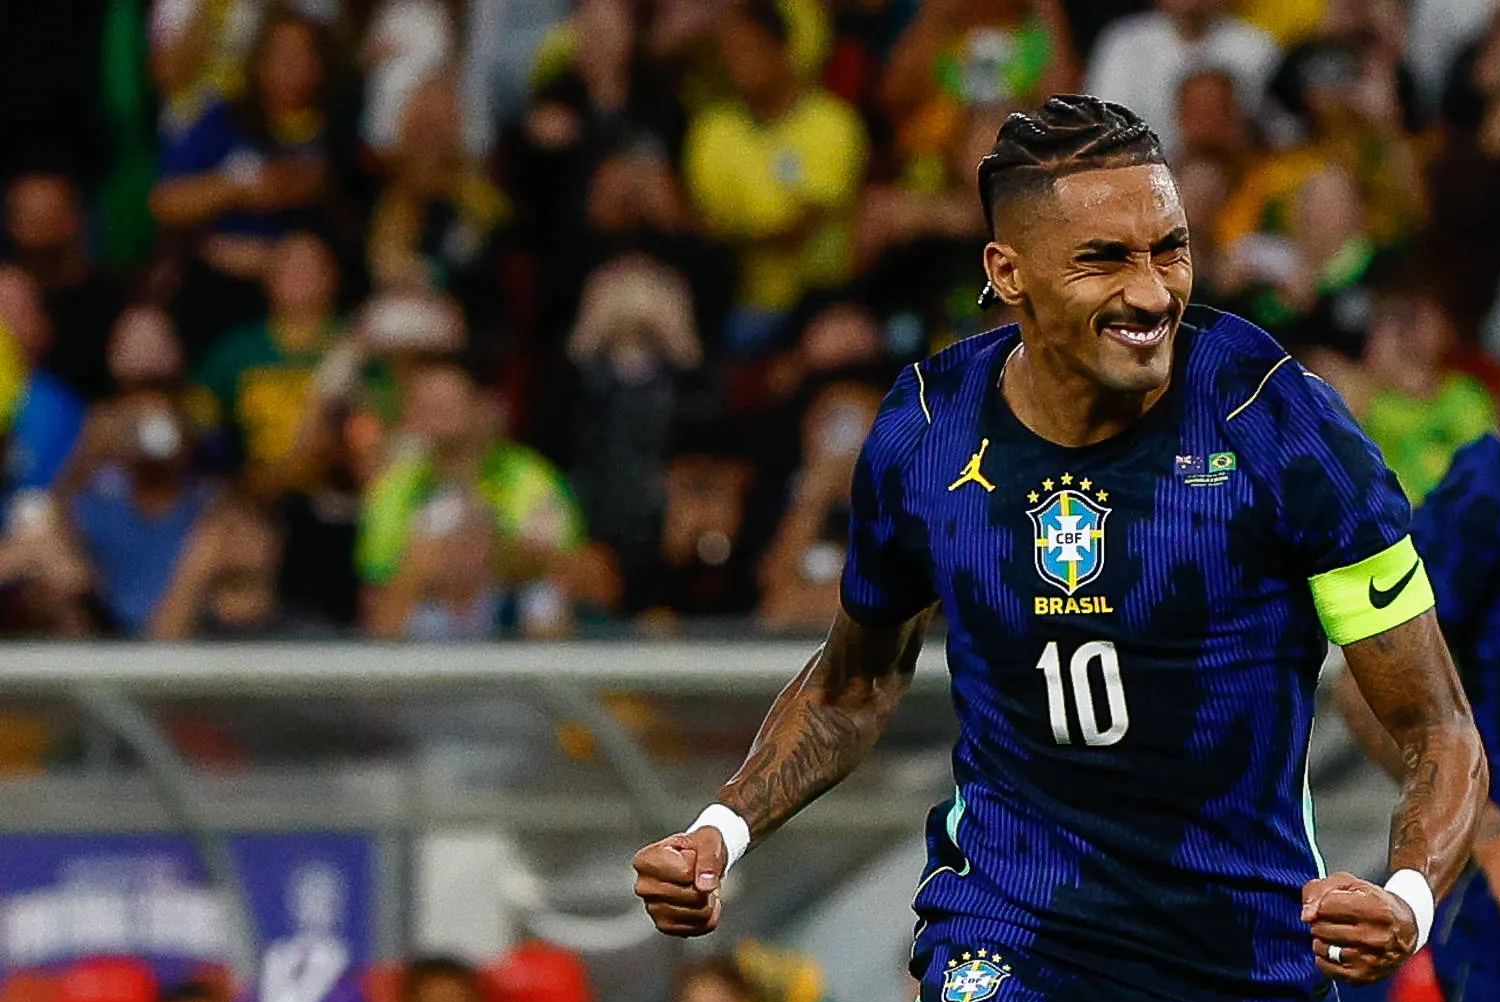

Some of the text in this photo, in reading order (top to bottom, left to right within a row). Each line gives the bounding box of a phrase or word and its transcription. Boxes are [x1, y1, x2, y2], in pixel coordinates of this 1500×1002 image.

[1056, 532, 1083, 545] CBF
[1034, 596, 1114, 615] BRASIL
[1036, 640, 1129, 746] 10
